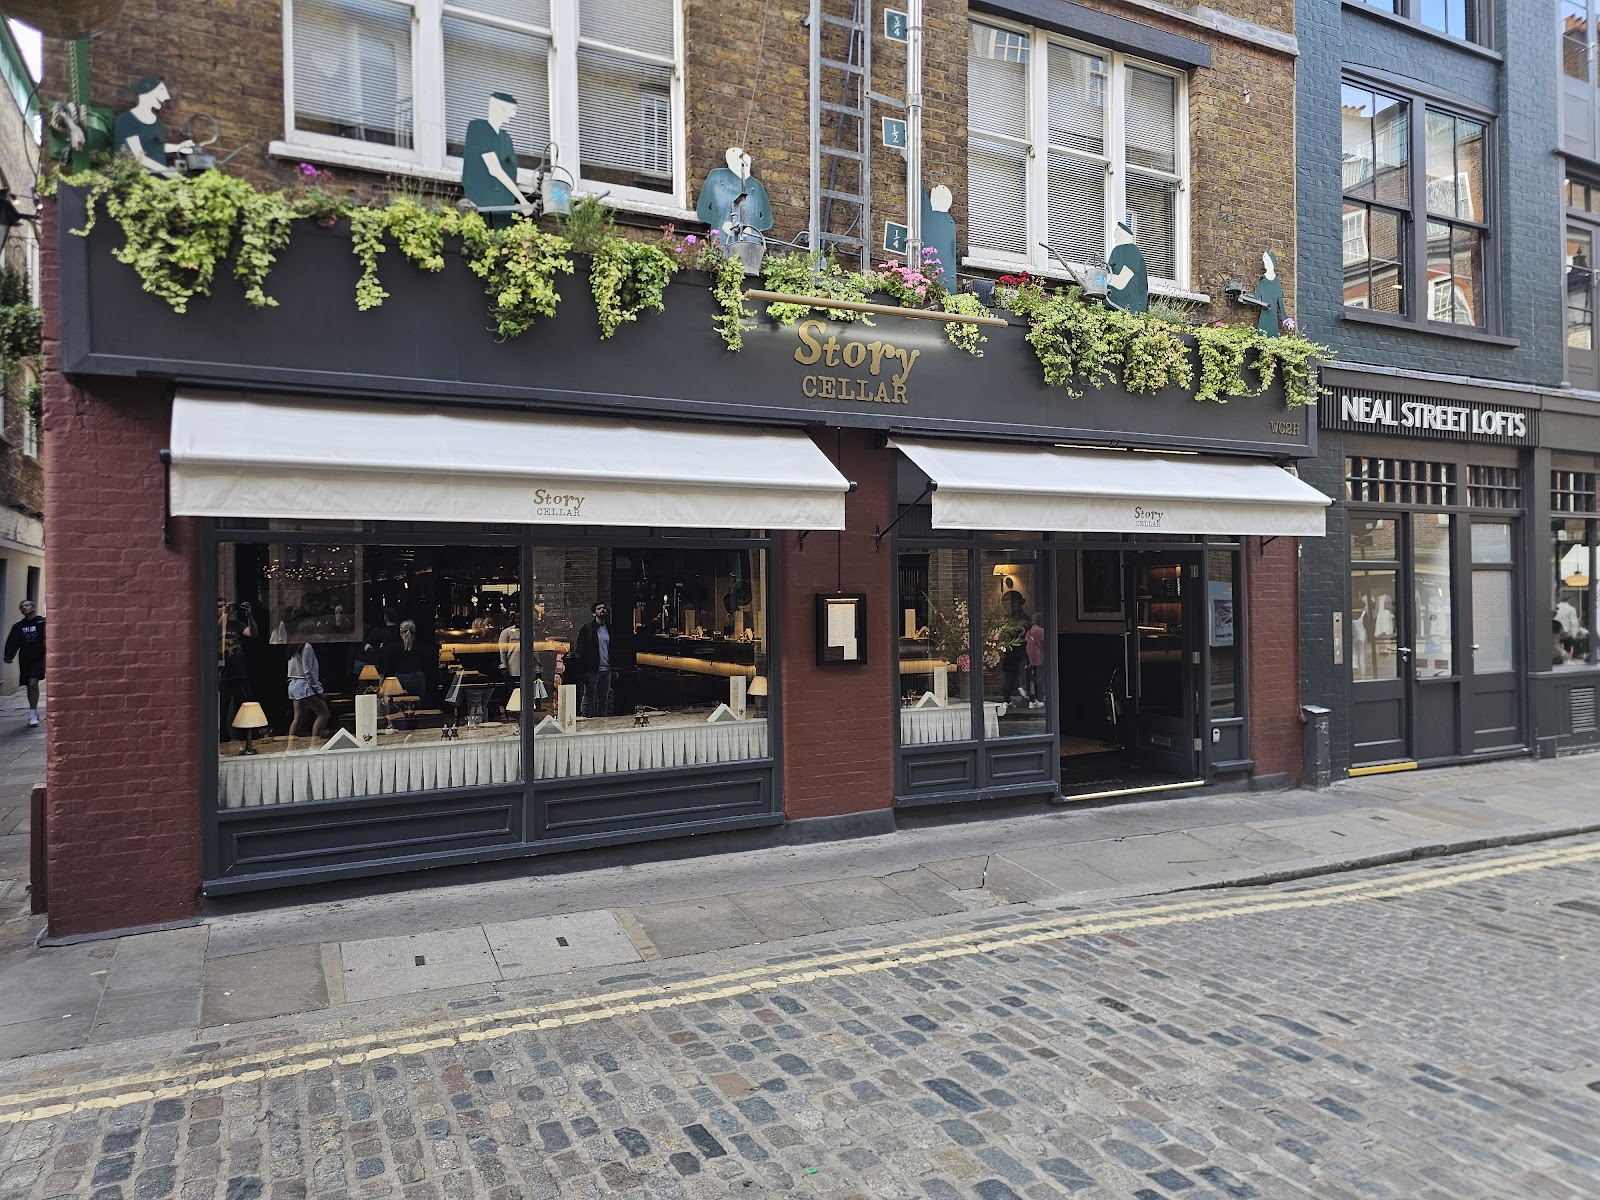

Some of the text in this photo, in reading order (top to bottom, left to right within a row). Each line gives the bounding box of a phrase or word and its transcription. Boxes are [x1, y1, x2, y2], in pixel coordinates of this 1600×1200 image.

[793, 319, 920, 385] Story
[802, 375, 908, 404] CELLAR
[1342, 395, 1526, 437] NEAL STREET LOFTS
[1270, 420, 1300, 435] WC2H
[533, 489, 585, 510] Story
[536, 507, 581, 517] CELLAR
[1134, 506, 1164, 522] Story
[1136, 520, 1161, 528] CELLAR
